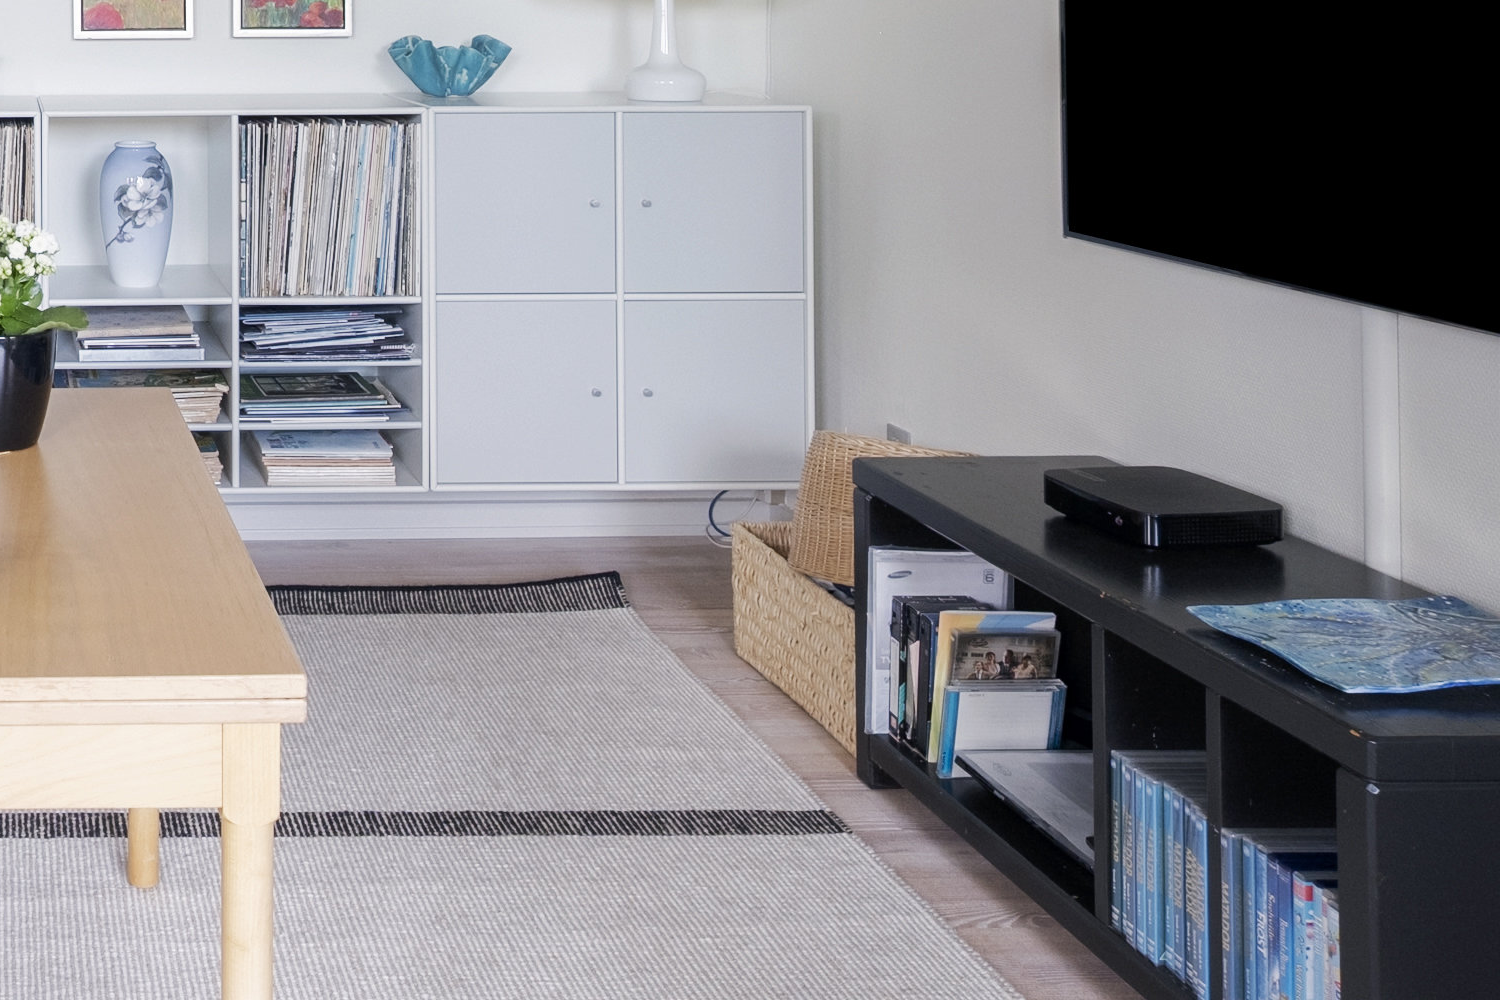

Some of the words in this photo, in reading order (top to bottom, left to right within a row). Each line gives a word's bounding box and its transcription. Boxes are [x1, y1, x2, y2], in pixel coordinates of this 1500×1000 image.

[1125, 811, 1133, 877] MATADOR
[1147, 828, 1155, 893] MATADOR
[1173, 841, 1182, 909] MATADOR
[1197, 861, 1205, 932] MATADOR
[1222, 881, 1230, 952] MATADOR
[1267, 892, 1275, 942] Snehvide
[1257, 910, 1266, 959] FROST
